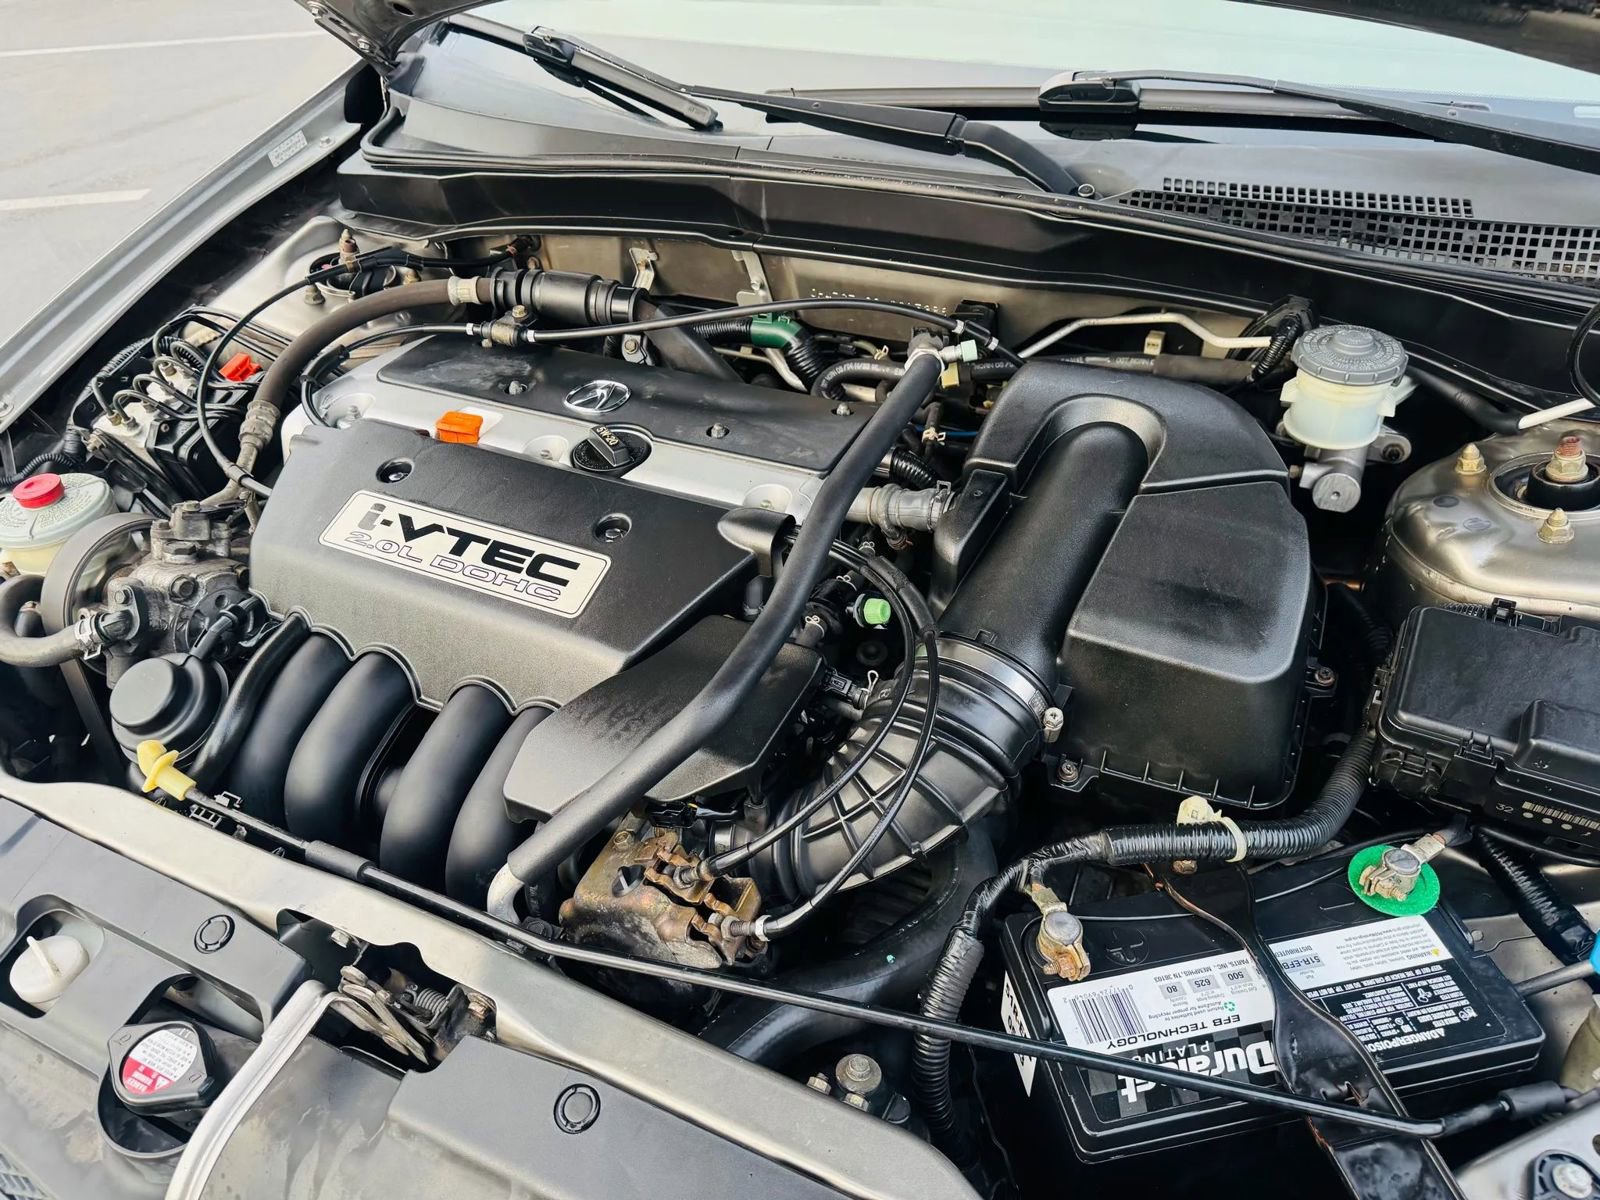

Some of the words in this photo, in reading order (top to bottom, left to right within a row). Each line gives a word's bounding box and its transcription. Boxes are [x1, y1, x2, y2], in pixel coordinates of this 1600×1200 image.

[596, 426, 619, 446] 5W-20
[358, 503, 581, 587] i-VTEC
[344, 532, 423, 563] 2.0L
[430, 554, 562, 601] DOHC
[1495, 803, 1514, 814] 32
[1282, 955, 1320, 970] 51R-EFB
[1194, 978, 1211, 988] 625
[1227, 971, 1245, 981] 500
[1166, 985, 1178, 994] 80
[1212, 1014, 1241, 1027] EFB
[1106, 1021, 1208, 1050] TECHNOLOGY
